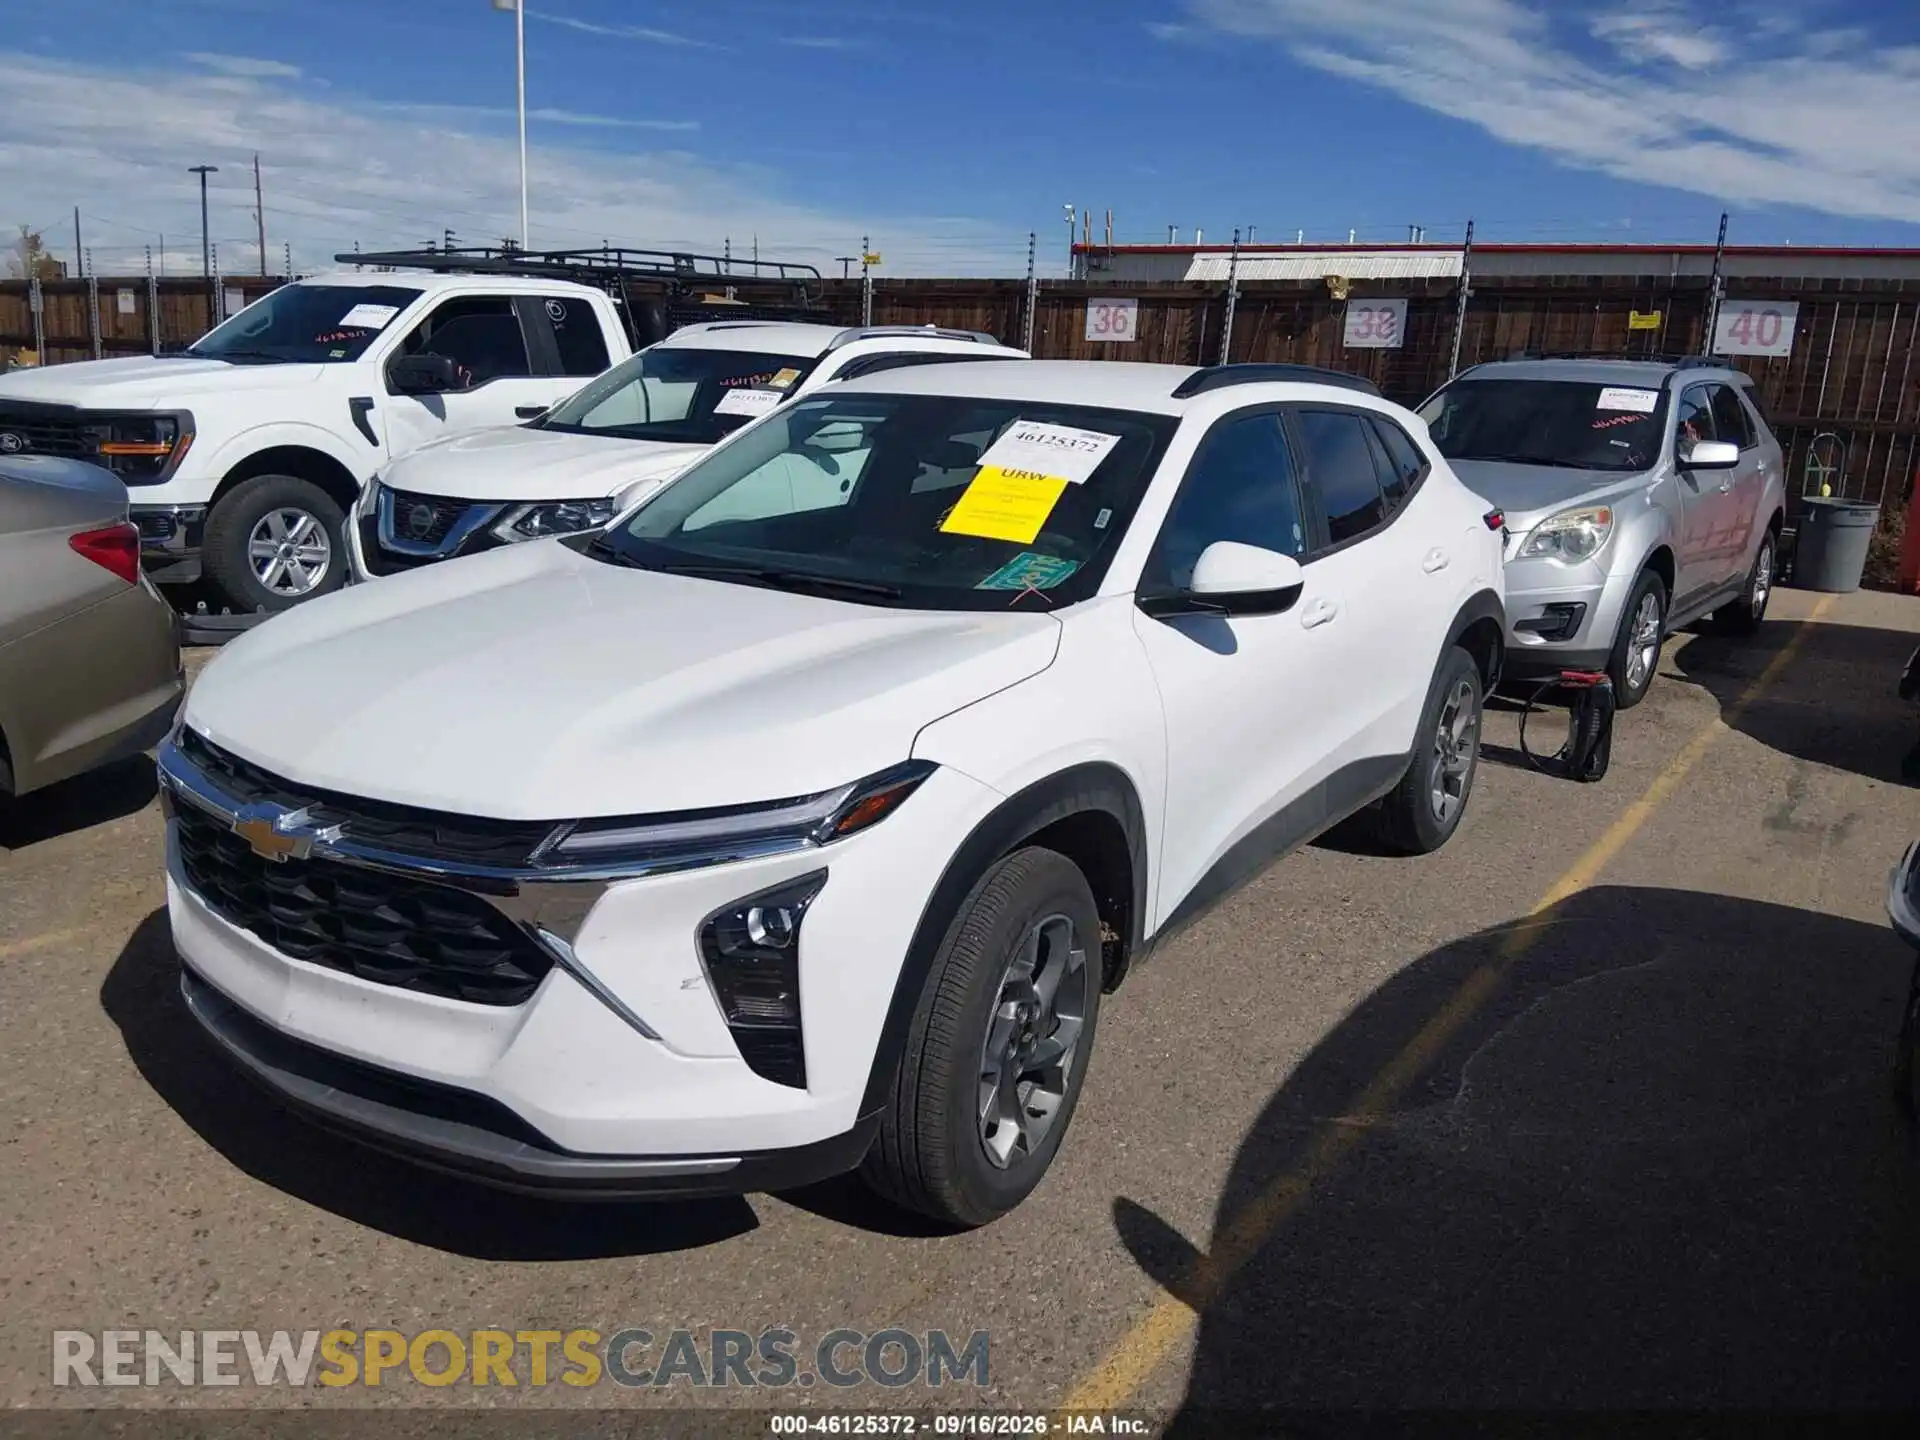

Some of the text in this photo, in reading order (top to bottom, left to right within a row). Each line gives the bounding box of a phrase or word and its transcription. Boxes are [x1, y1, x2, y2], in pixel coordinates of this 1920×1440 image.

[1095, 305, 1129, 334] 36
[1353, 306, 1396, 339] 38
[1728, 309, 1782, 347] 40
[1015, 431, 1099, 453] 46125372
[1001, 468, 1047, 481] URW
